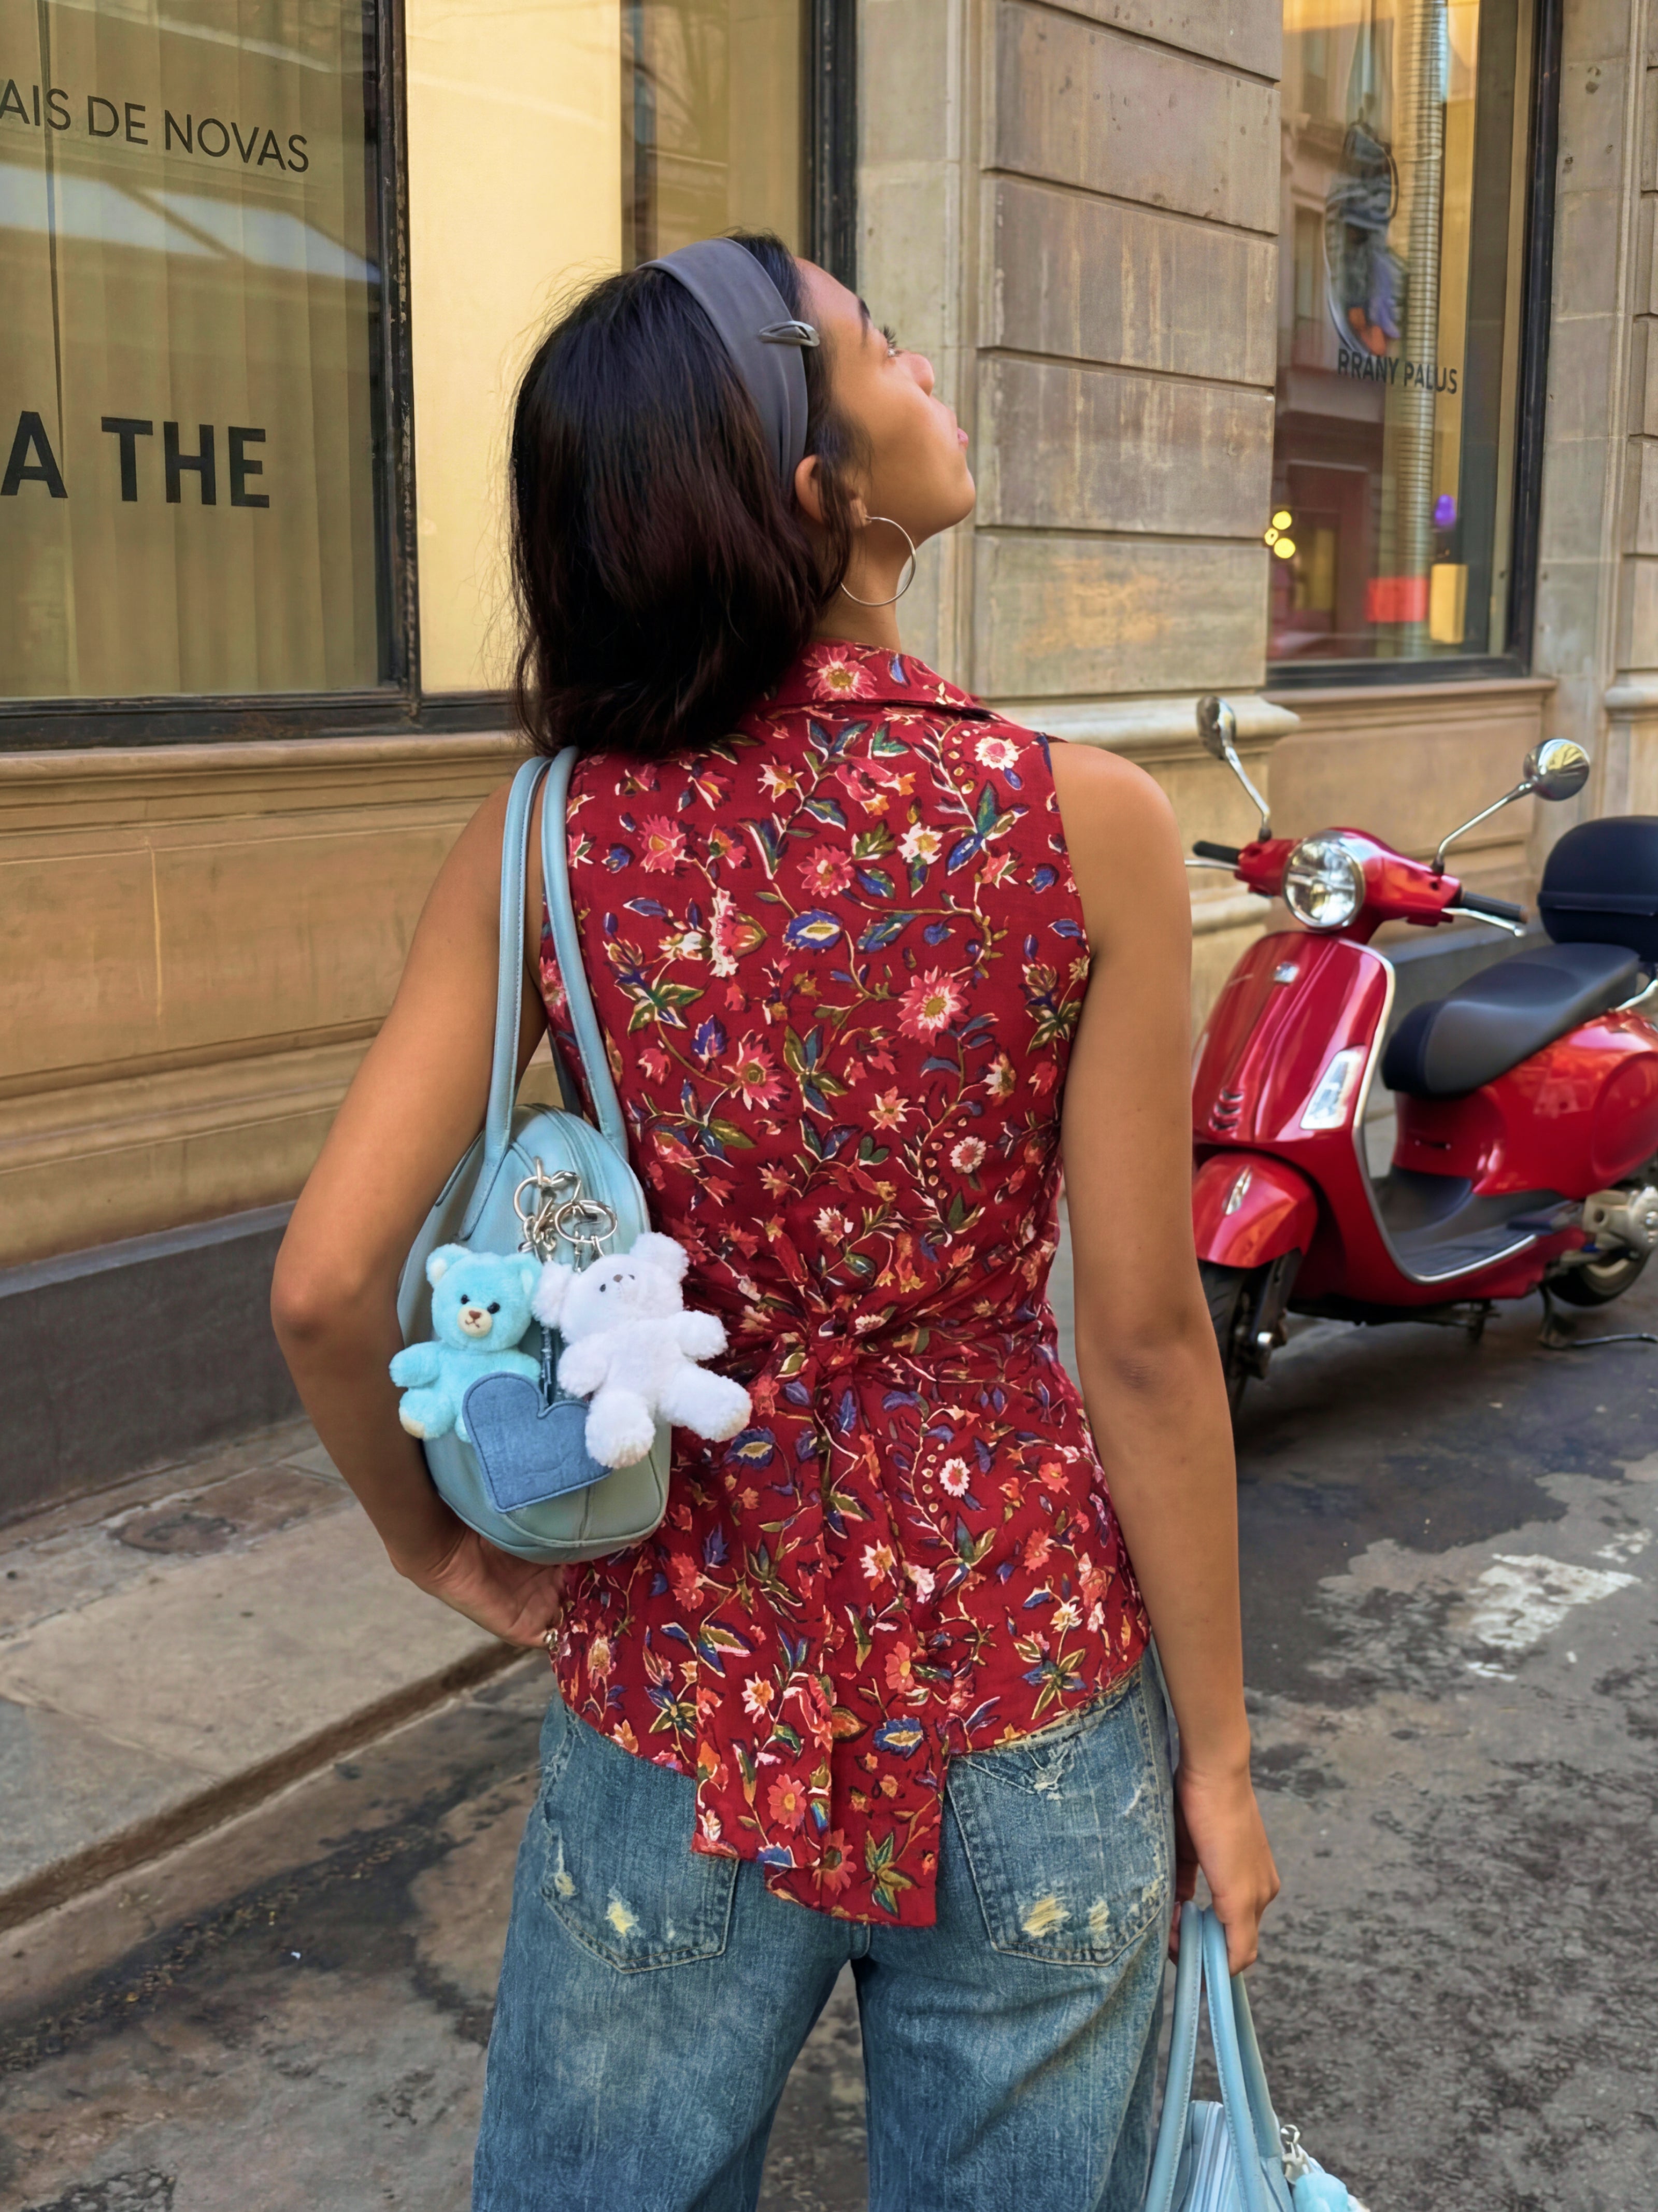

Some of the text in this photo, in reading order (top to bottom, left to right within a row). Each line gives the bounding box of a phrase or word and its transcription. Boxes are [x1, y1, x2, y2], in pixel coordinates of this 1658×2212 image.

[0, 79, 309, 173] AIS DE NOVAS
[1404, 361, 1457, 395] PALUS
[0, 410, 270, 508] A THE
